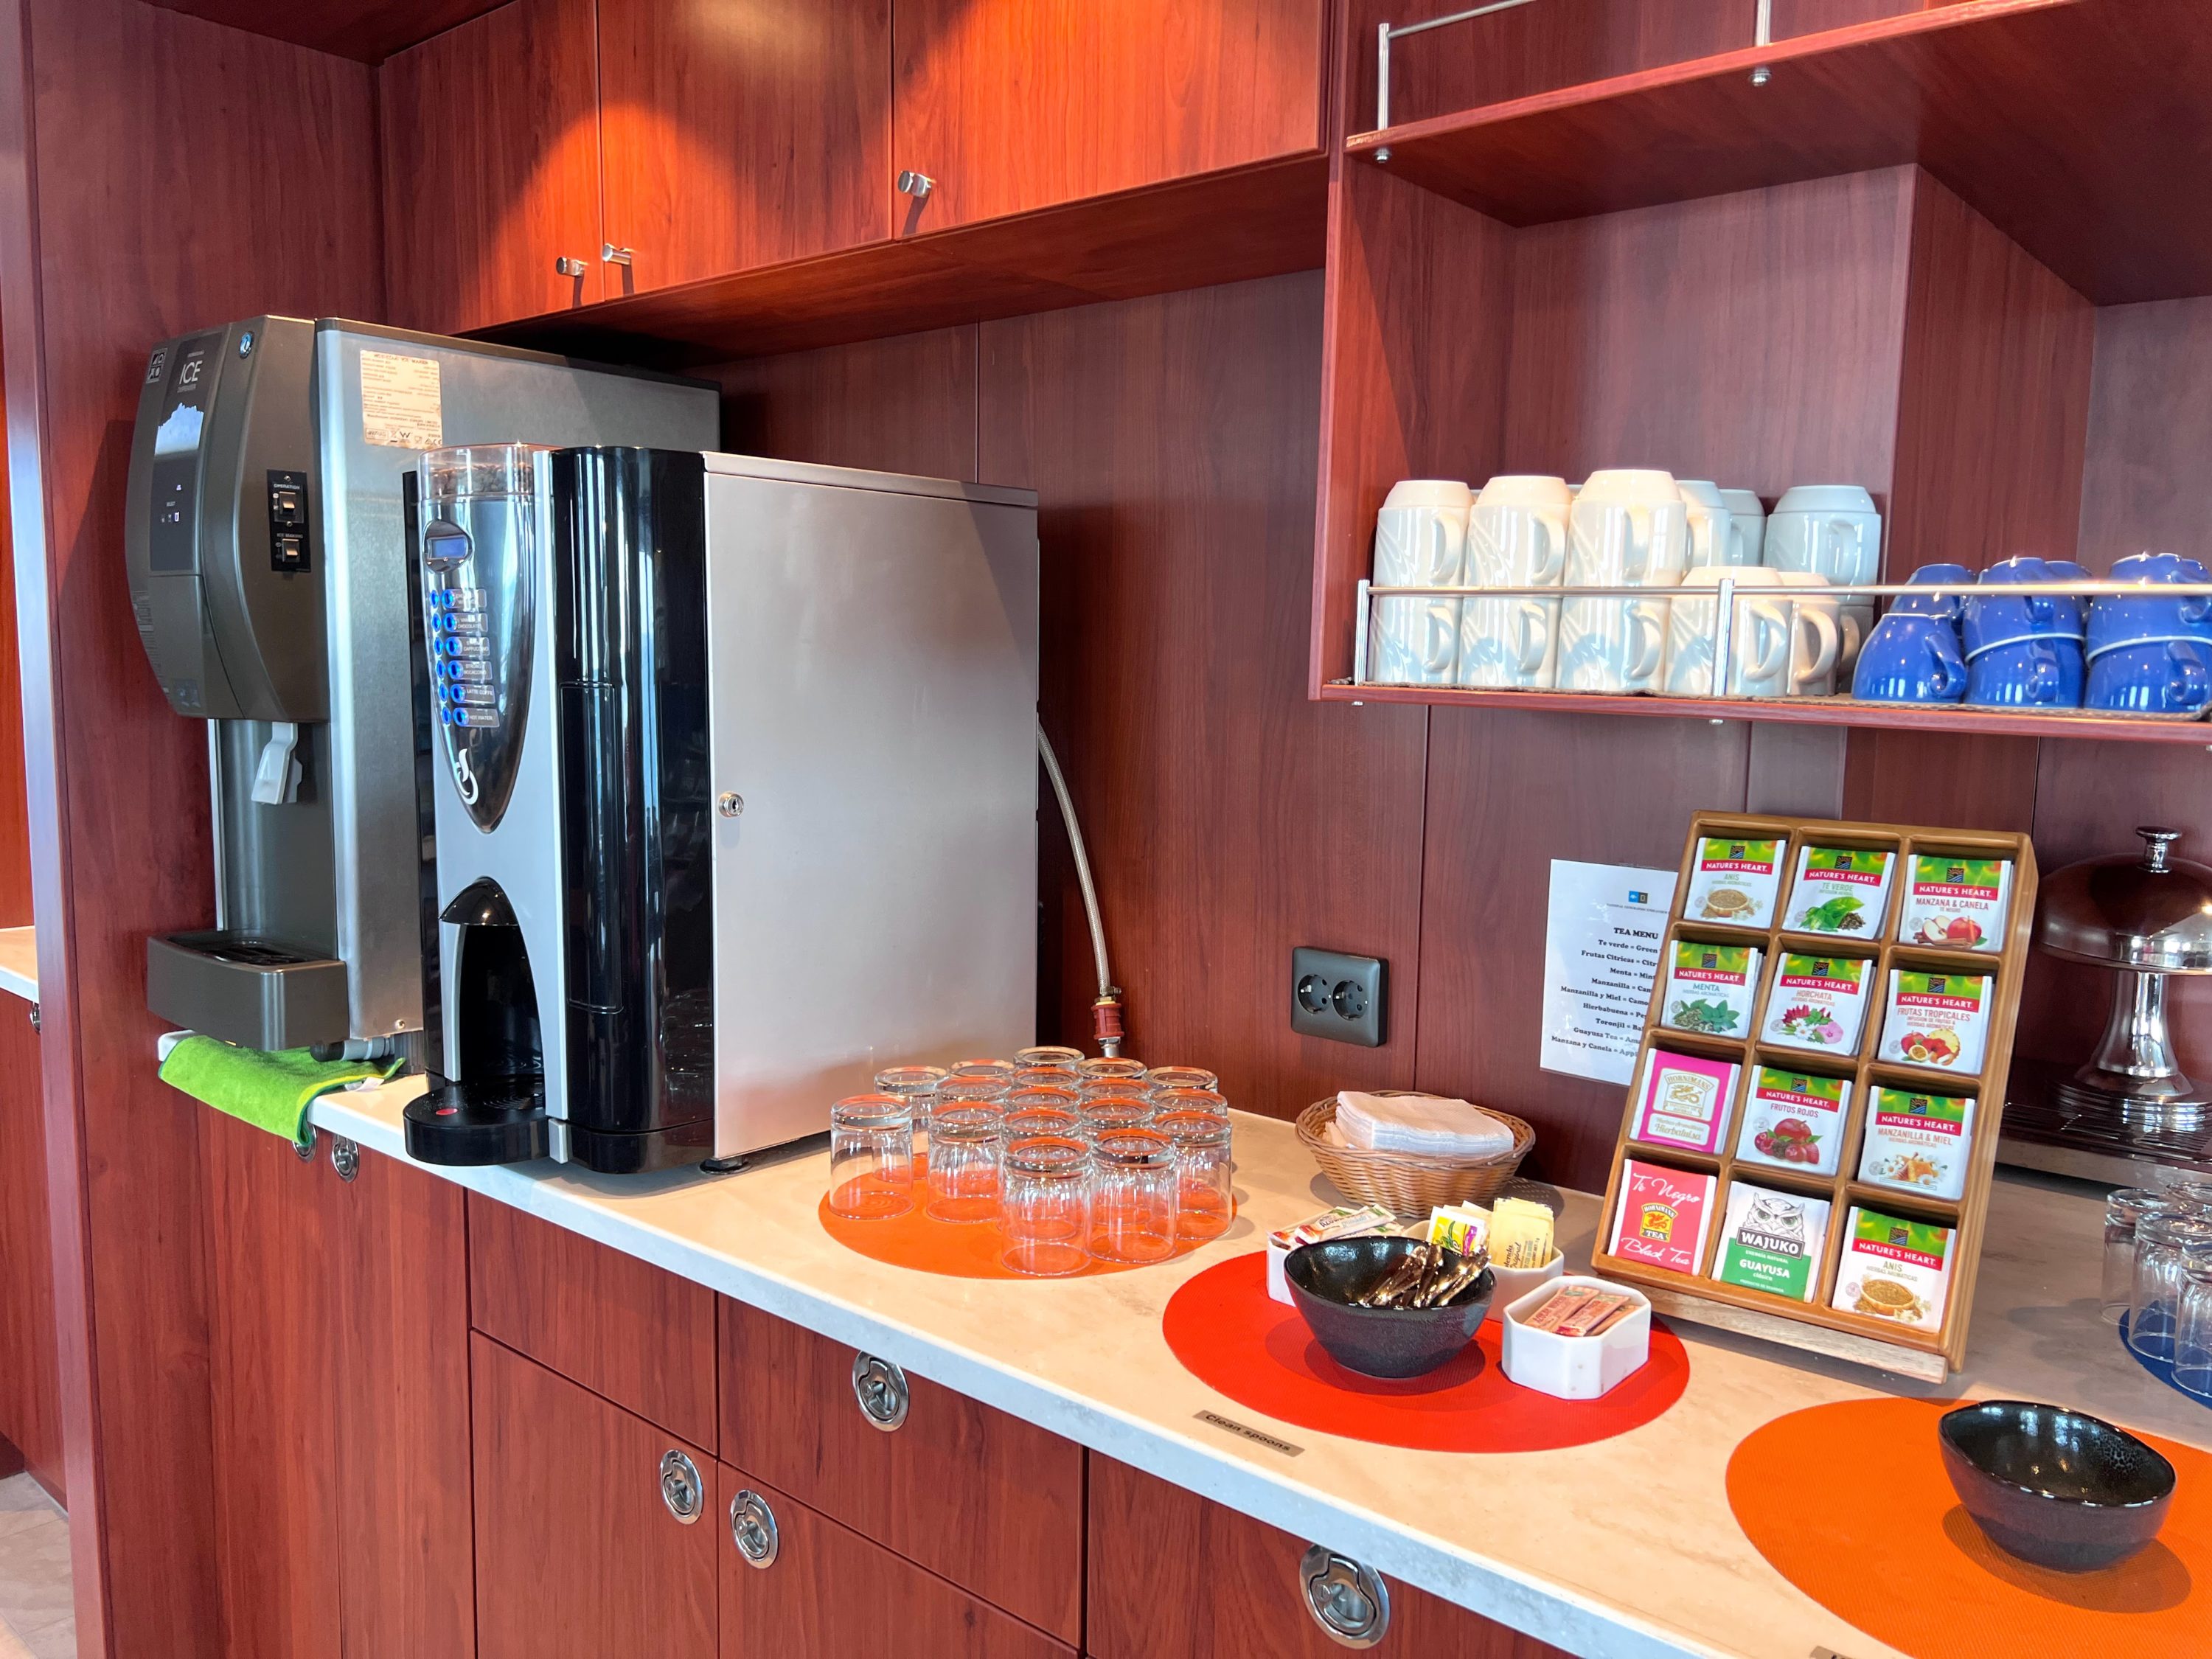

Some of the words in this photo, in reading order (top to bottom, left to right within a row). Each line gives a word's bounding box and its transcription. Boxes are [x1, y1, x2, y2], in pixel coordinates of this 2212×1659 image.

[179, 361, 203, 385] ICE
[1809, 872, 1845, 880] NATURE'S
[1831, 883, 1854, 892] VERDE
[1919, 886, 1958, 894] NATURE'S
[1916, 897, 1950, 907] MANZANA
[1959, 901, 1989, 911] CANELA
[1613, 927, 1631, 936] TEA
[1632, 930, 1658, 939] MENU
[1581, 950, 1604, 959] Frutas
[1636, 945, 1658, 953] Green
[1610, 967, 1632, 976] Menta
[1679, 970, 1712, 979] NATURE'S
[1591, 978, 1630, 990] Manzanilla
[1693, 983, 1720, 992] MENTA
[1786, 978, 1822, 986] NATURE'S
[1561, 986, 1599, 998] Manzanilla
[1606, 993, 1621, 1001] Miel
[1796, 990, 1832, 1001] HORCHATA
[1901, 996, 1940, 1005] NATURE'S
[1583, 1003, 1628, 1016] Hierbabuena
[1897, 1007, 1923, 1017] FRUTAS
[1924, 1009, 1971, 1022] TROPICALES
[1596, 1018, 1625, 1029] Toronjil
[1573, 1027, 1604, 1037] Guayusa
[1605, 1032, 1618, 1040] Tea
[1551, 1035, 1581, 1046] Manzana
[1588, 1043, 1612, 1053] Canela
[1667, 1075, 1711, 1091] HORNIMANS
[1766, 1091, 1801, 1102] NATURE'S
[1770, 1103, 1796, 1114] FRUTOS
[1797, 1107, 1819, 1118] ROJOS
[1881, 1116, 1921, 1126] NATURE'S
[1877, 1127, 1924, 1141] MANZANILLA
[1925, 1133, 1930, 1141] &
[1933, 1134, 1952, 1146] MIEL
[1651, 1178, 1700, 1207] Negro
[1644, 1205, 1674, 1218] HORNIMANS
[1645, 1230, 1665, 1240] TEA
[1742, 1232, 1799, 1254] WAJUKO
[1621, 1237, 1666, 1262] Black
[1669, 1247, 1691, 1265] Tea
[1859, 1242, 1902, 1257] NATURE'S
[1767, 1255, 1789, 1264] NATURAL
[1739, 1259, 1790, 1279] GUAYUSA
[1882, 1261, 1903, 1272] ANIS
[1206, 1414, 1242, 1431] Clean
[1243, 1430, 1291, 1452] spoons
